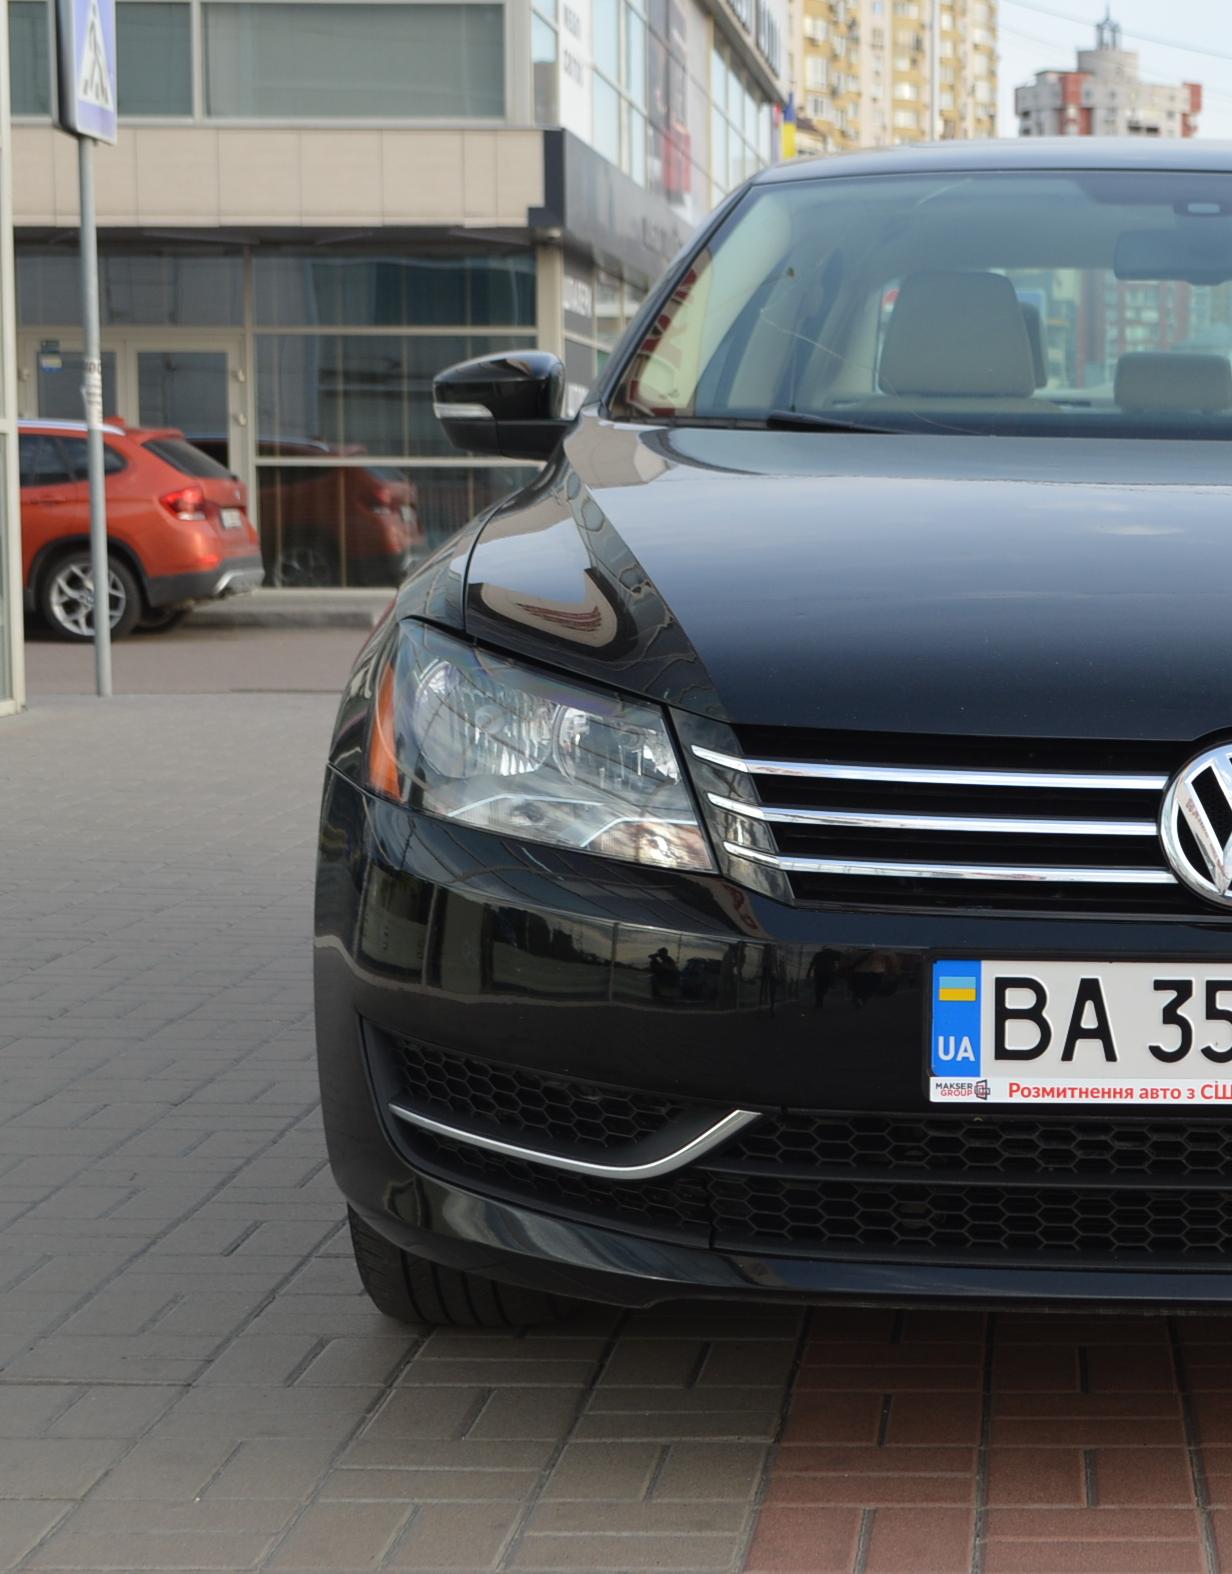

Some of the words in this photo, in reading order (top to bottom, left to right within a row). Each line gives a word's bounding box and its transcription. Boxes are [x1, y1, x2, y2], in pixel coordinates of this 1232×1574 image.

[995, 977, 1118, 1062] BA
[938, 1036, 975, 1062] UA
[940, 1089, 973, 1097] GROUP
[1008, 1082, 1134, 1099] Розмитнення
[1139, 1087, 1182, 1100] авто
[1187, 1088, 1196, 1100] з
